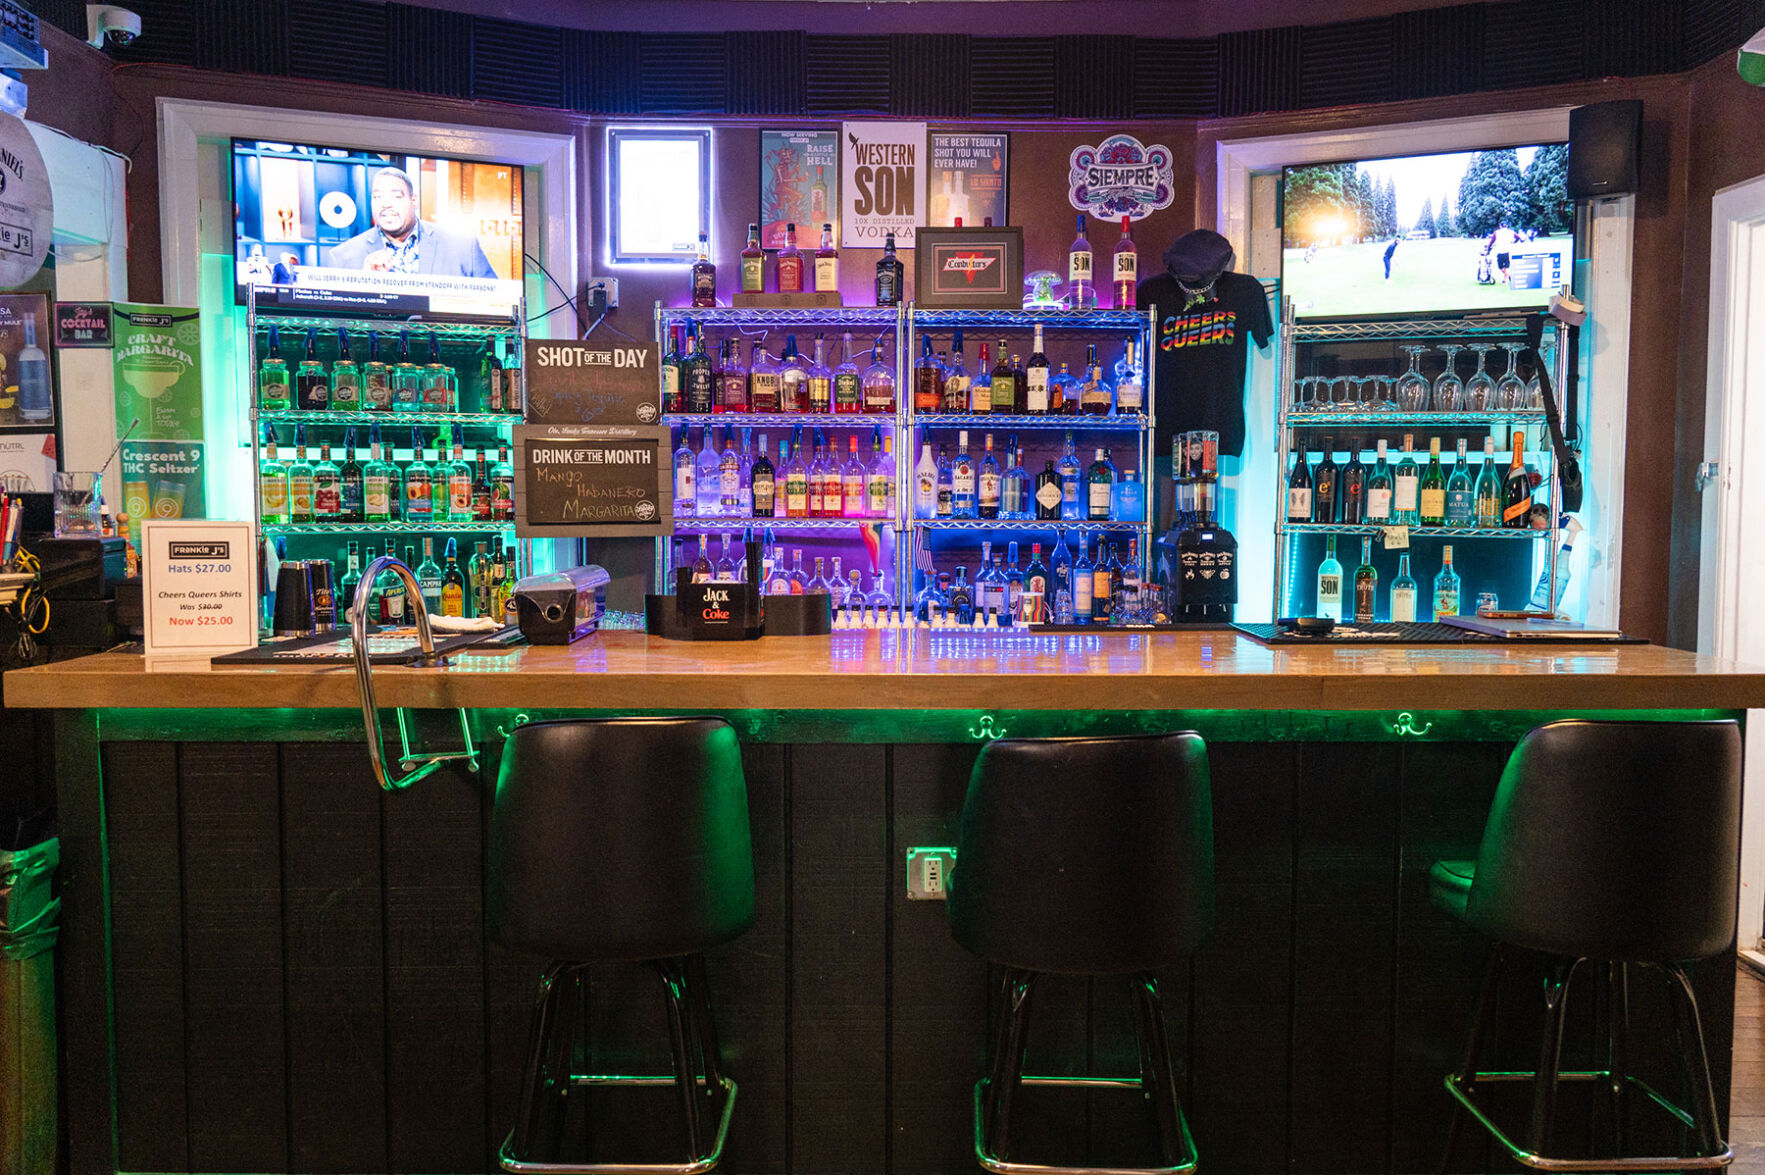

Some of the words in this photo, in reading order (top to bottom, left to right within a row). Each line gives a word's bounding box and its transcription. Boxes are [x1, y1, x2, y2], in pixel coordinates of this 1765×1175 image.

[935, 138, 949, 146] THE
[951, 138, 969, 147] BEST
[972, 138, 1001, 147] TEQUILA
[807, 144, 833, 153] RAISE
[934, 148, 954, 157] SHOT
[956, 148, 971, 157] YOU
[972, 149, 991, 157] WILL
[856, 144, 915, 165] WESTERN
[807, 156, 833, 166] HELL
[934, 159, 953, 168] EVER
[955, 159, 977, 168] HAVE!
[1088, 166, 1154, 187] SIEMPRE
[855, 166, 915, 216] SON
[856, 227, 914, 238] VODKA
[1074, 257, 1090, 271] SON
[1118, 258, 1134, 272] SON
[61, 319, 105, 329] COCKTAIL
[1163, 311, 1236, 335] CHEERS
[74, 330, 93, 339] BAR
[128, 333, 176, 346] CRAFT
[1160, 322, 1235, 351] QUEERS
[116, 344, 194, 367] MARGARITA
[537, 347, 585, 367] SHOT
[584, 353, 595, 363] OF
[596, 353, 612, 363] THE
[614, 348, 648, 368] DAY
[757, 376, 775, 384] KNOB
[123, 449, 186, 461] Crescent
[190, 449, 200, 461] 9
[533, 449, 574, 464] DRINK
[574, 452, 583, 461] OF
[587, 452, 603, 462] THE
[605, 450, 651, 464] MONTH
[123, 463, 145, 473] THC
[149, 463, 196, 473] Seltzer
[168, 564, 192, 573] Hats
[195, 564, 231, 574] $27.00
[1321, 580, 1338, 594] SON
[158, 591, 185, 599] Cheers
[188, 591, 217, 599] Queers
[219, 590, 242, 598] Shirts
[703, 588, 731, 602] JACK
[702, 608, 730, 619] Coke
[169, 617, 194, 626] Now
[197, 616, 233, 625] $25.00
